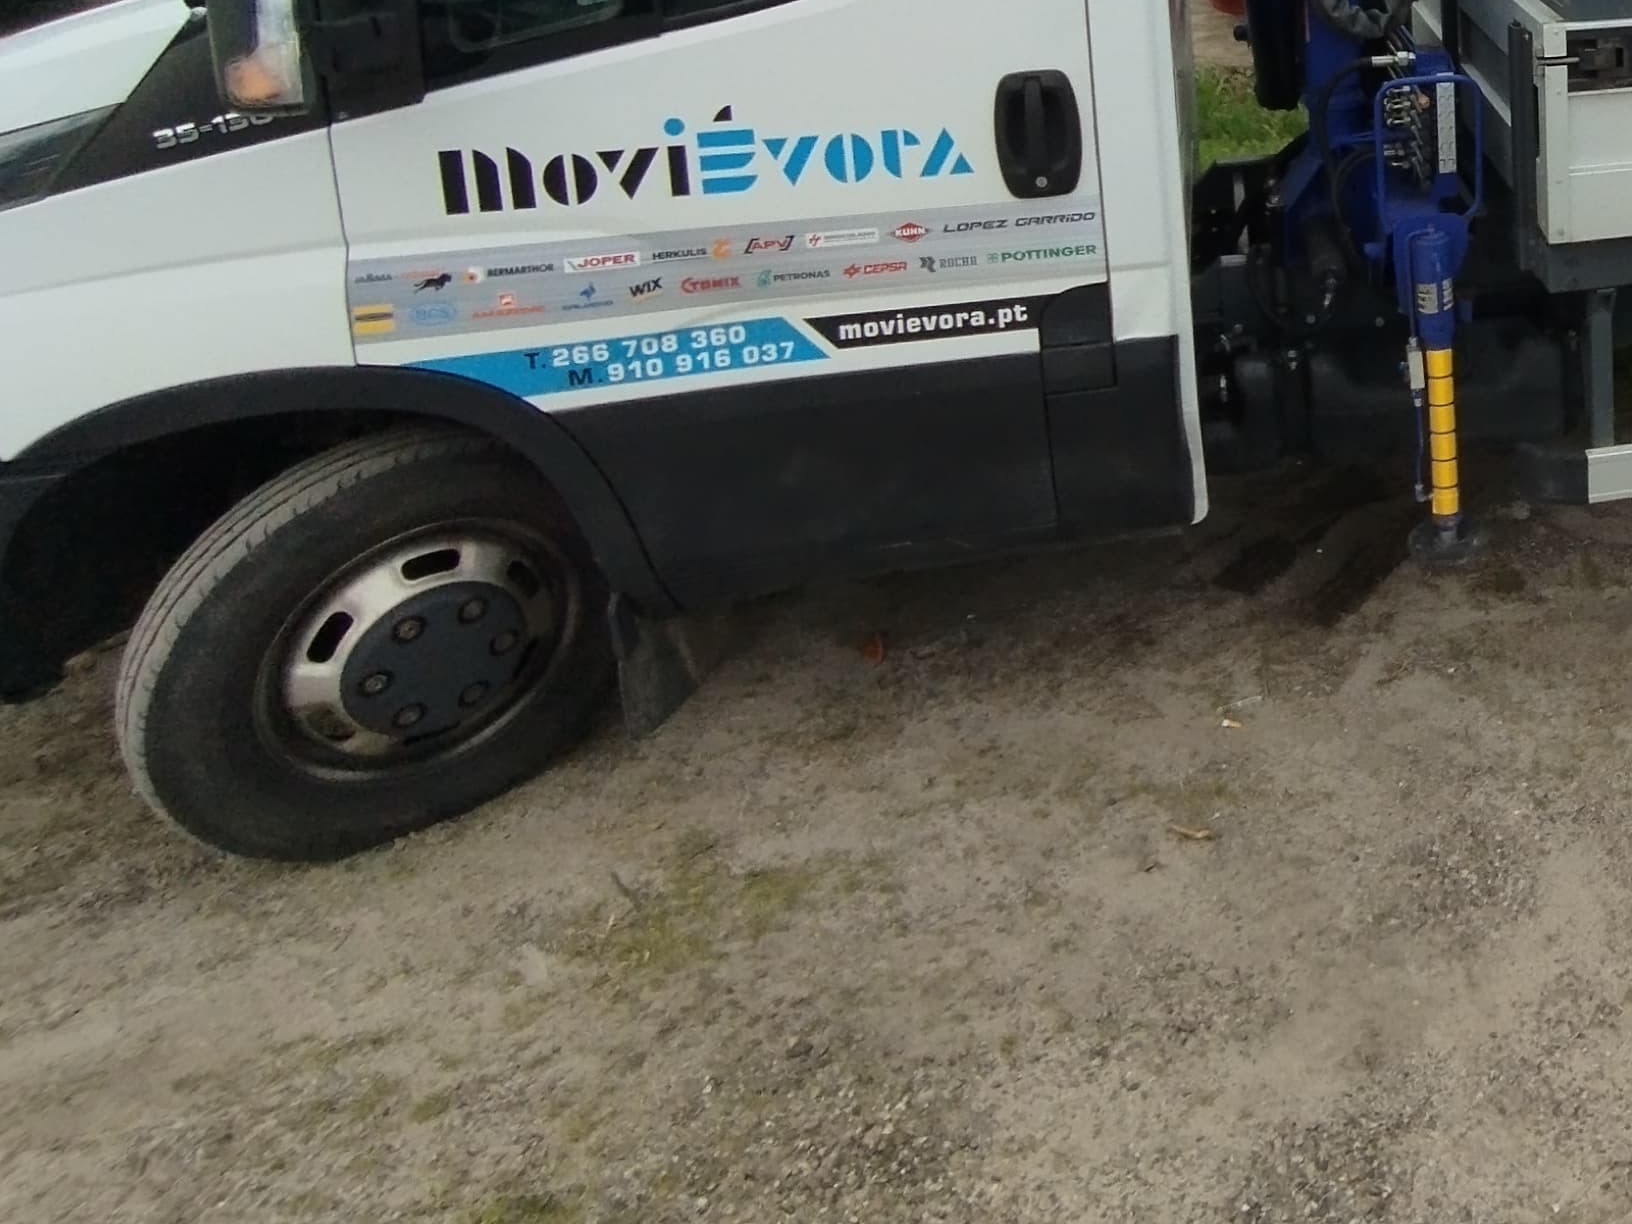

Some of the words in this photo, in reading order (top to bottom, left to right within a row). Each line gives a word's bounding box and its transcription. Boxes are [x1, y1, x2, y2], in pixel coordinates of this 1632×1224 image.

[895, 226, 926, 237] KUHN
[943, 218, 1008, 234] LOPEZ
[577, 254, 635, 269] JOPER
[653, 247, 707, 261] HERKULIS
[863, 261, 908, 275] CEPSA
[773, 269, 831, 283] PETRONAS
[629, 276, 663, 298] WIX
[839, 303, 1029, 341] movievora.pt
[622, 333, 679, 358] 708
[691, 325, 747, 350] 360
[675, 349, 732, 374] 916
[743, 341, 795, 365] 037
